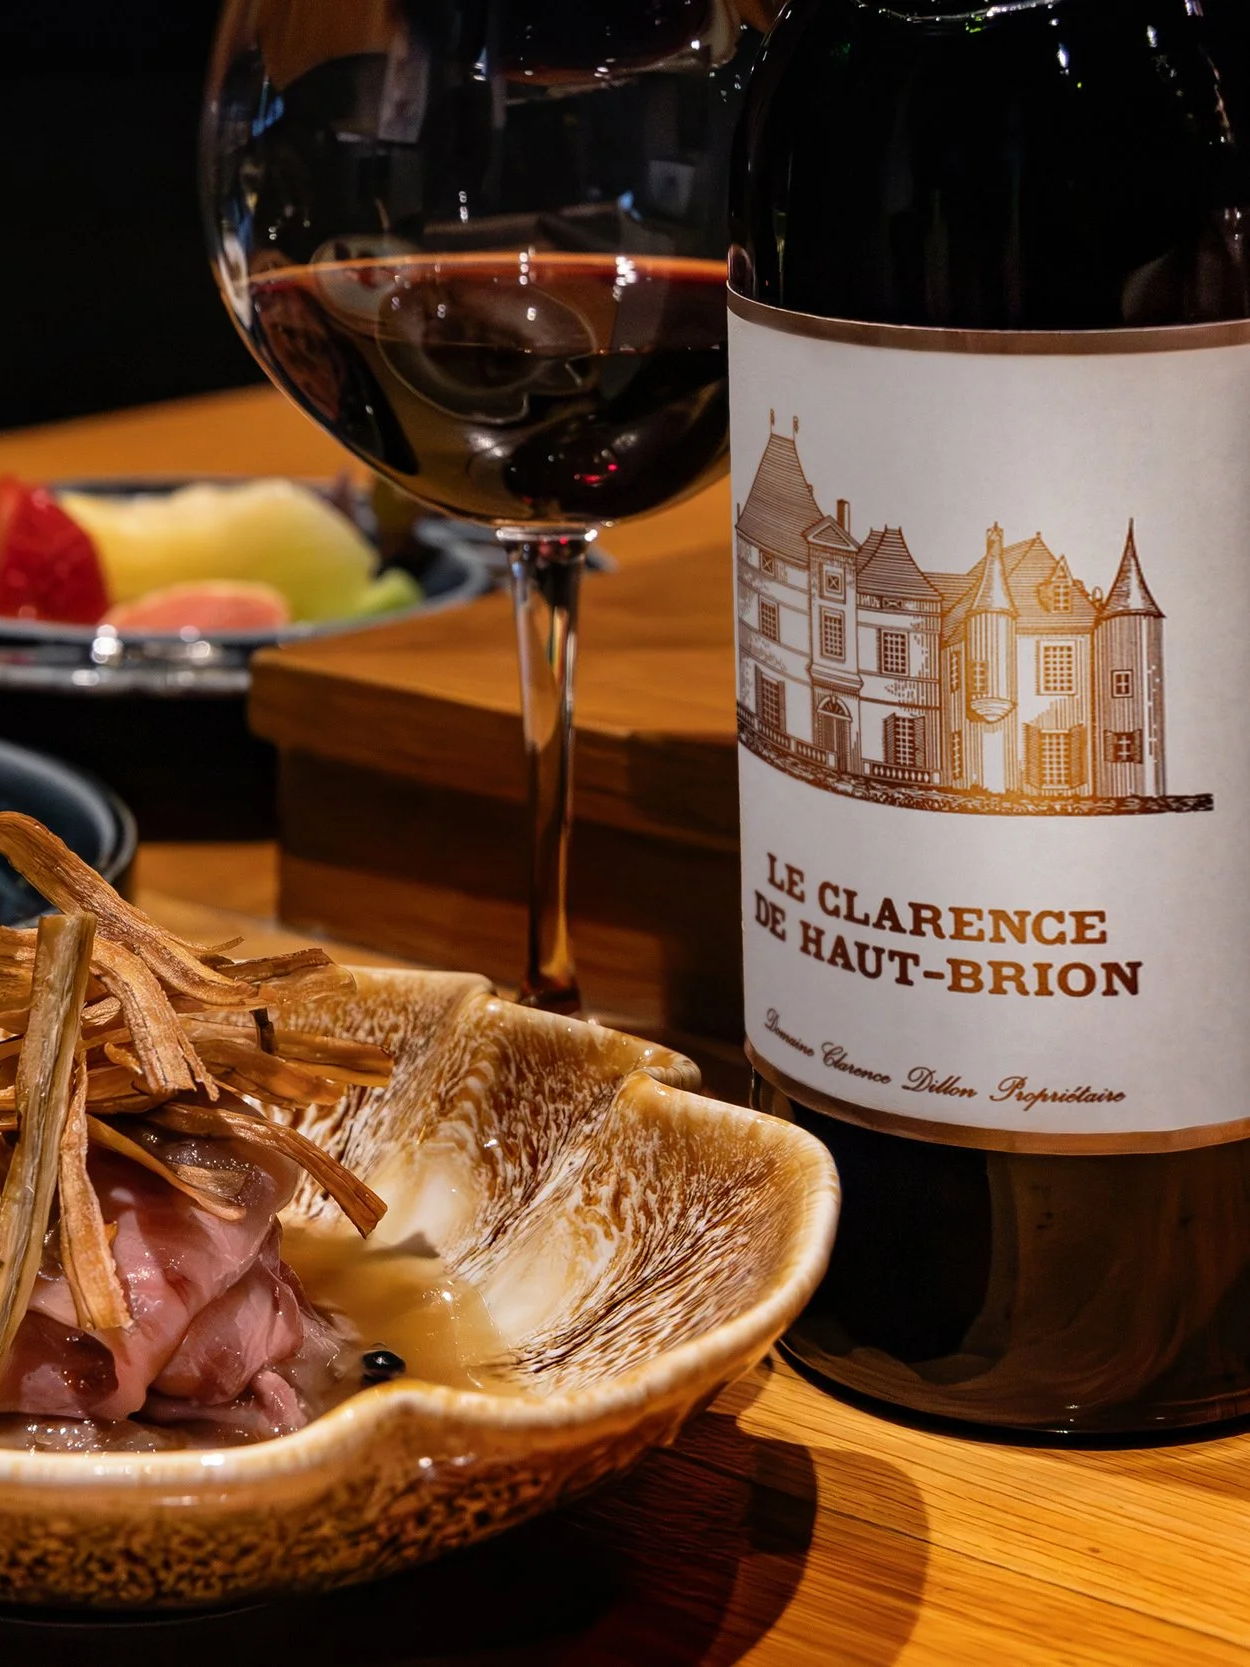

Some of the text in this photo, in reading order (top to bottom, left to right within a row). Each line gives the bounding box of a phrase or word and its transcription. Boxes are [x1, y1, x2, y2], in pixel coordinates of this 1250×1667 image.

[754, 890, 1144, 998] DE HAUT-BRION
[766, 852, 1108, 946] LE CLARENCE
[763, 1007, 1127, 1111] Domaine Clarence Dillon Propriétaire
